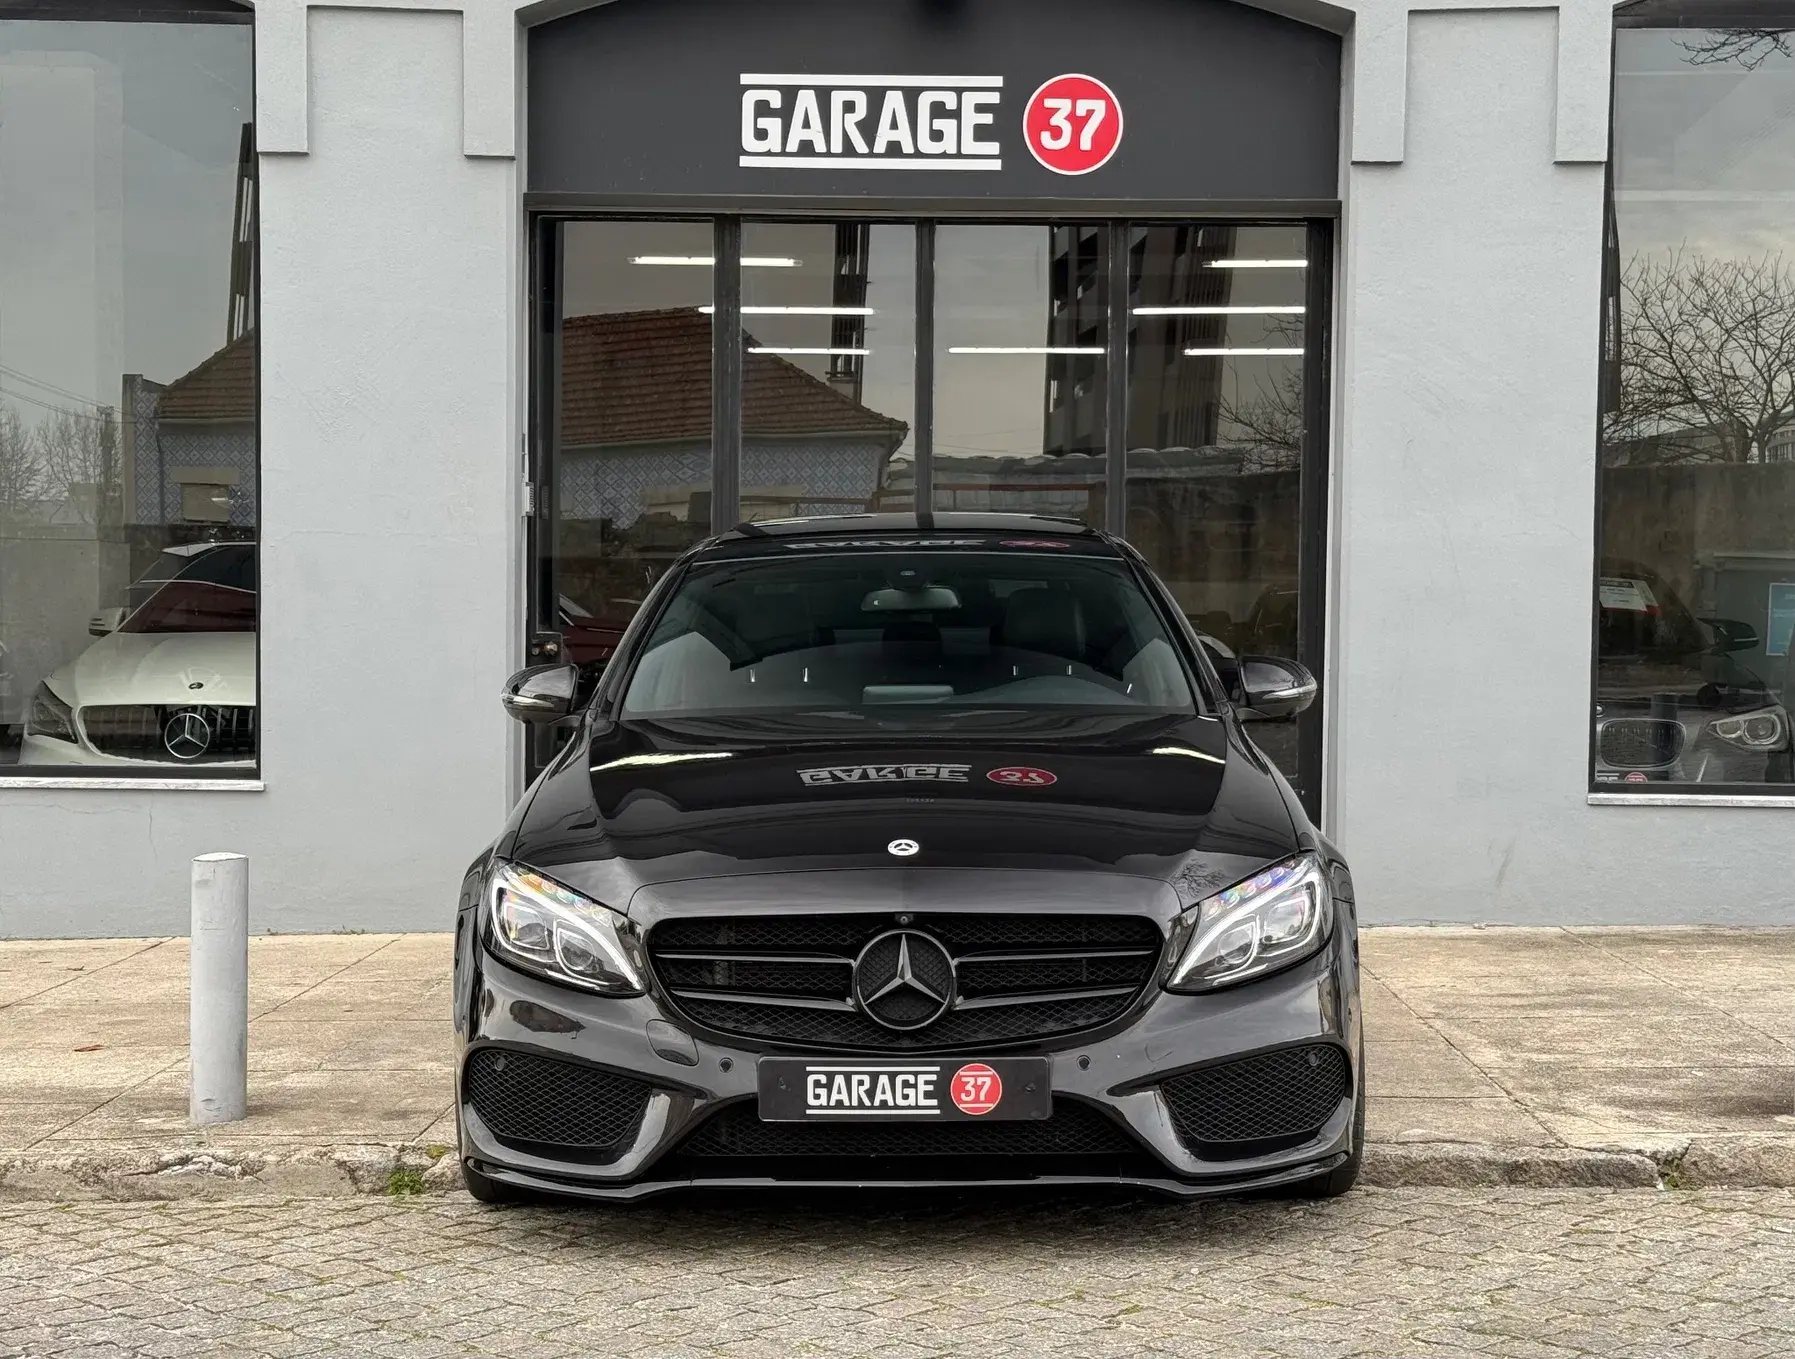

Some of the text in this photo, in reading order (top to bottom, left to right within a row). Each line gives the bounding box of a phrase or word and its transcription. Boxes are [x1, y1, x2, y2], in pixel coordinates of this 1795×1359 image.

[741, 89, 1106, 155] GARAGE 37
[806, 1073, 992, 1107] GARAGE 37
